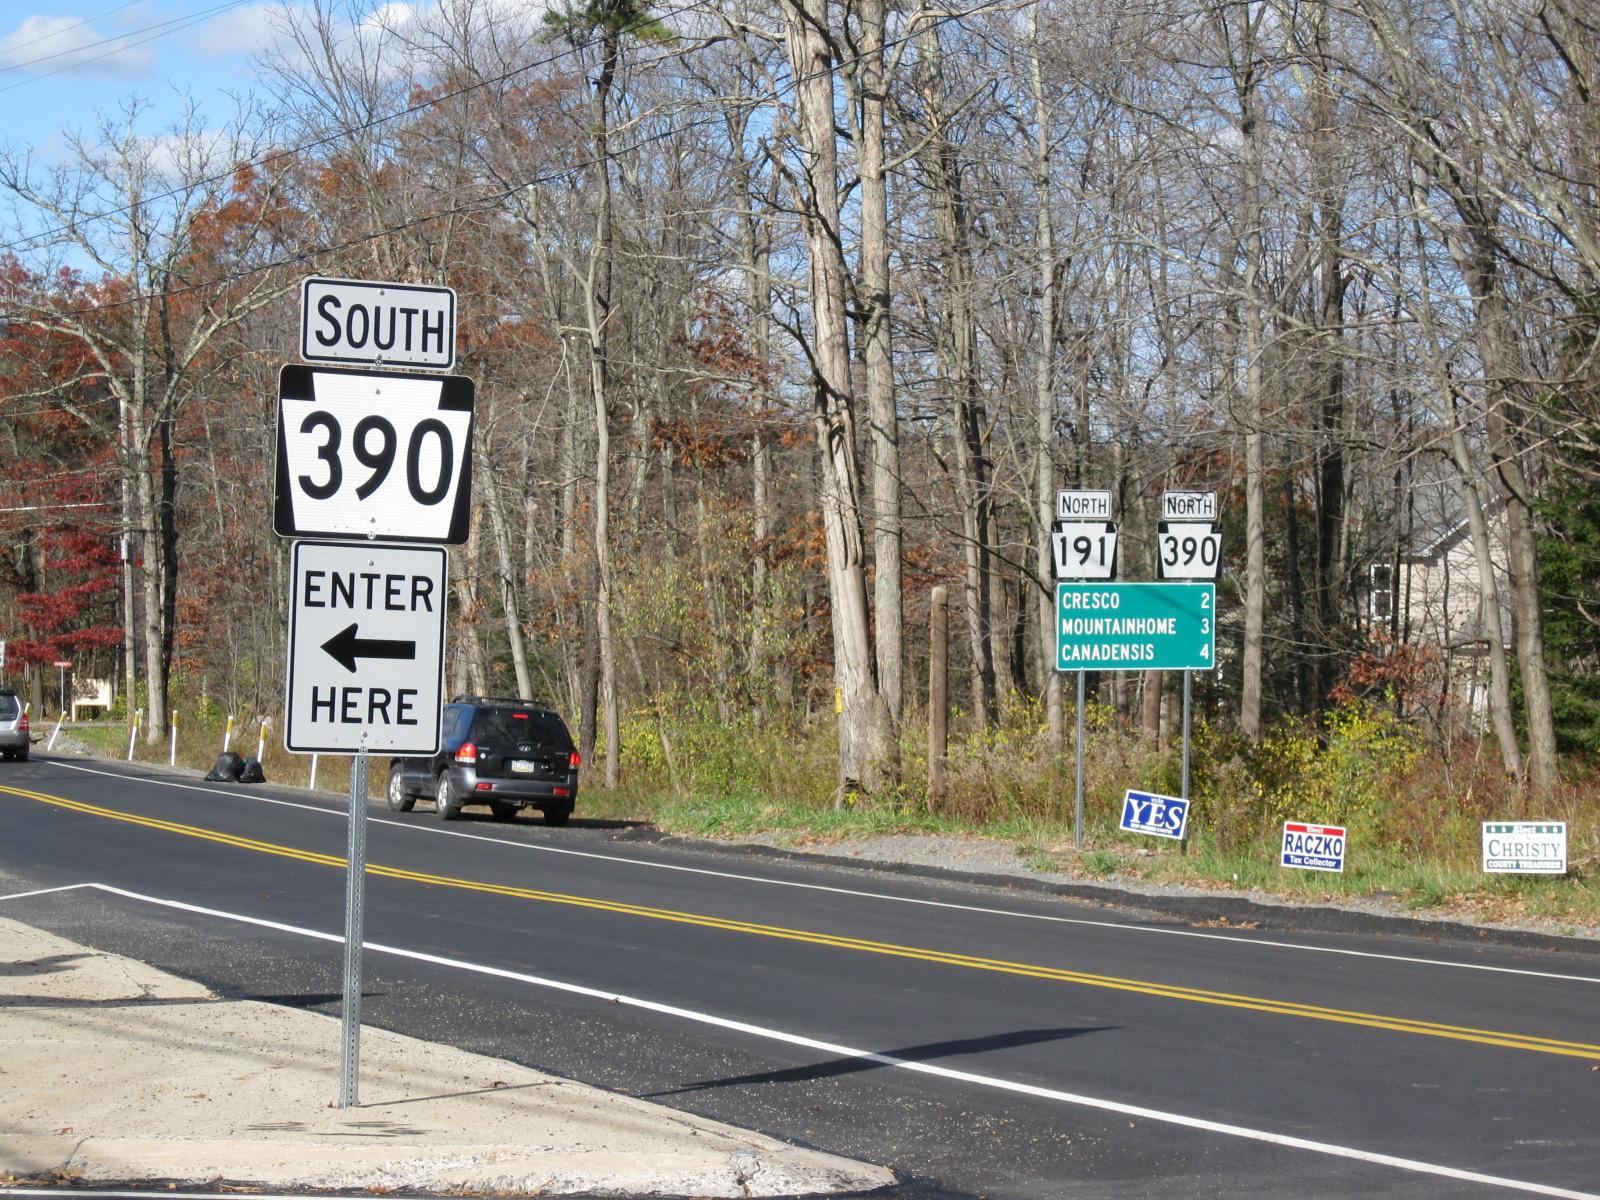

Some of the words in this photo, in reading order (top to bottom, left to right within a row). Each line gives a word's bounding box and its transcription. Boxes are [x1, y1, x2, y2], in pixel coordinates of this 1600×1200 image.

[315, 294, 444, 354] SOUTH
[298, 410, 454, 506] 390
[1062, 496, 1107, 514] NORTH
[1167, 497, 1212, 514] NORTH
[1060, 536, 1105, 566] 191
[1164, 536, 1217, 566] 390
[304, 570, 434, 612] ENTER
[1062, 592, 1120, 609] CRESCO
[1201, 592, 1210, 609] 2
[1062, 618, 1176, 635] MOUNTAINHOME
[1200, 619, 1209, 634] 3
[1062, 644, 1154, 661] CANADENSIS
[1199, 643, 1209, 660] 4
[311, 685, 418, 725] HERE
[1129, 798, 1183, 830] YES
[1285, 833, 1343, 857] RACZKO
[1488, 839, 1560, 857] CHRISTY
[1290, 855, 1303, 865] Tax
[1303, 857, 1337, 868] Collector
